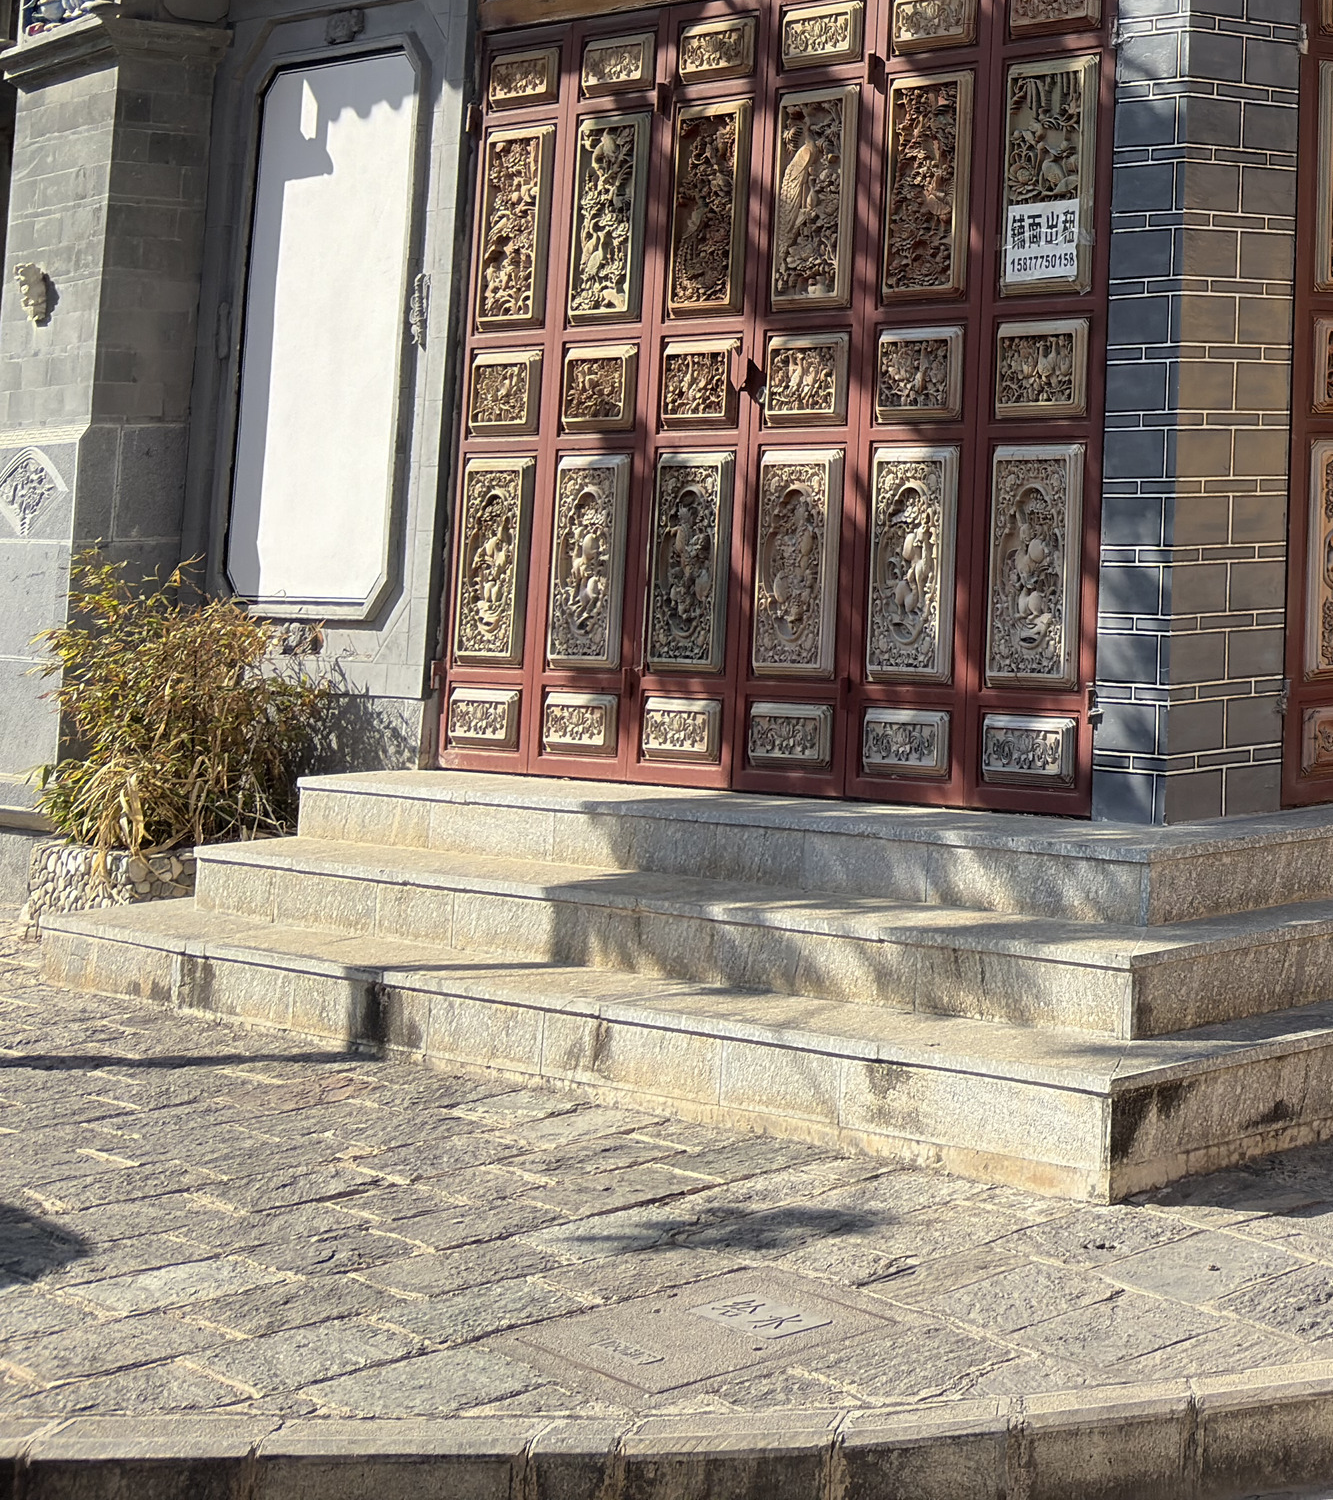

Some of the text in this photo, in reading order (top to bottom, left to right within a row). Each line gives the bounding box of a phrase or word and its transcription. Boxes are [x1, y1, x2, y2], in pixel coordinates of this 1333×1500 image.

[1011, 209, 1075, 250] 铺面出租
[1010, 252, 1075, 272] 15877750158
[711, 1299, 803, 1330] 给水
